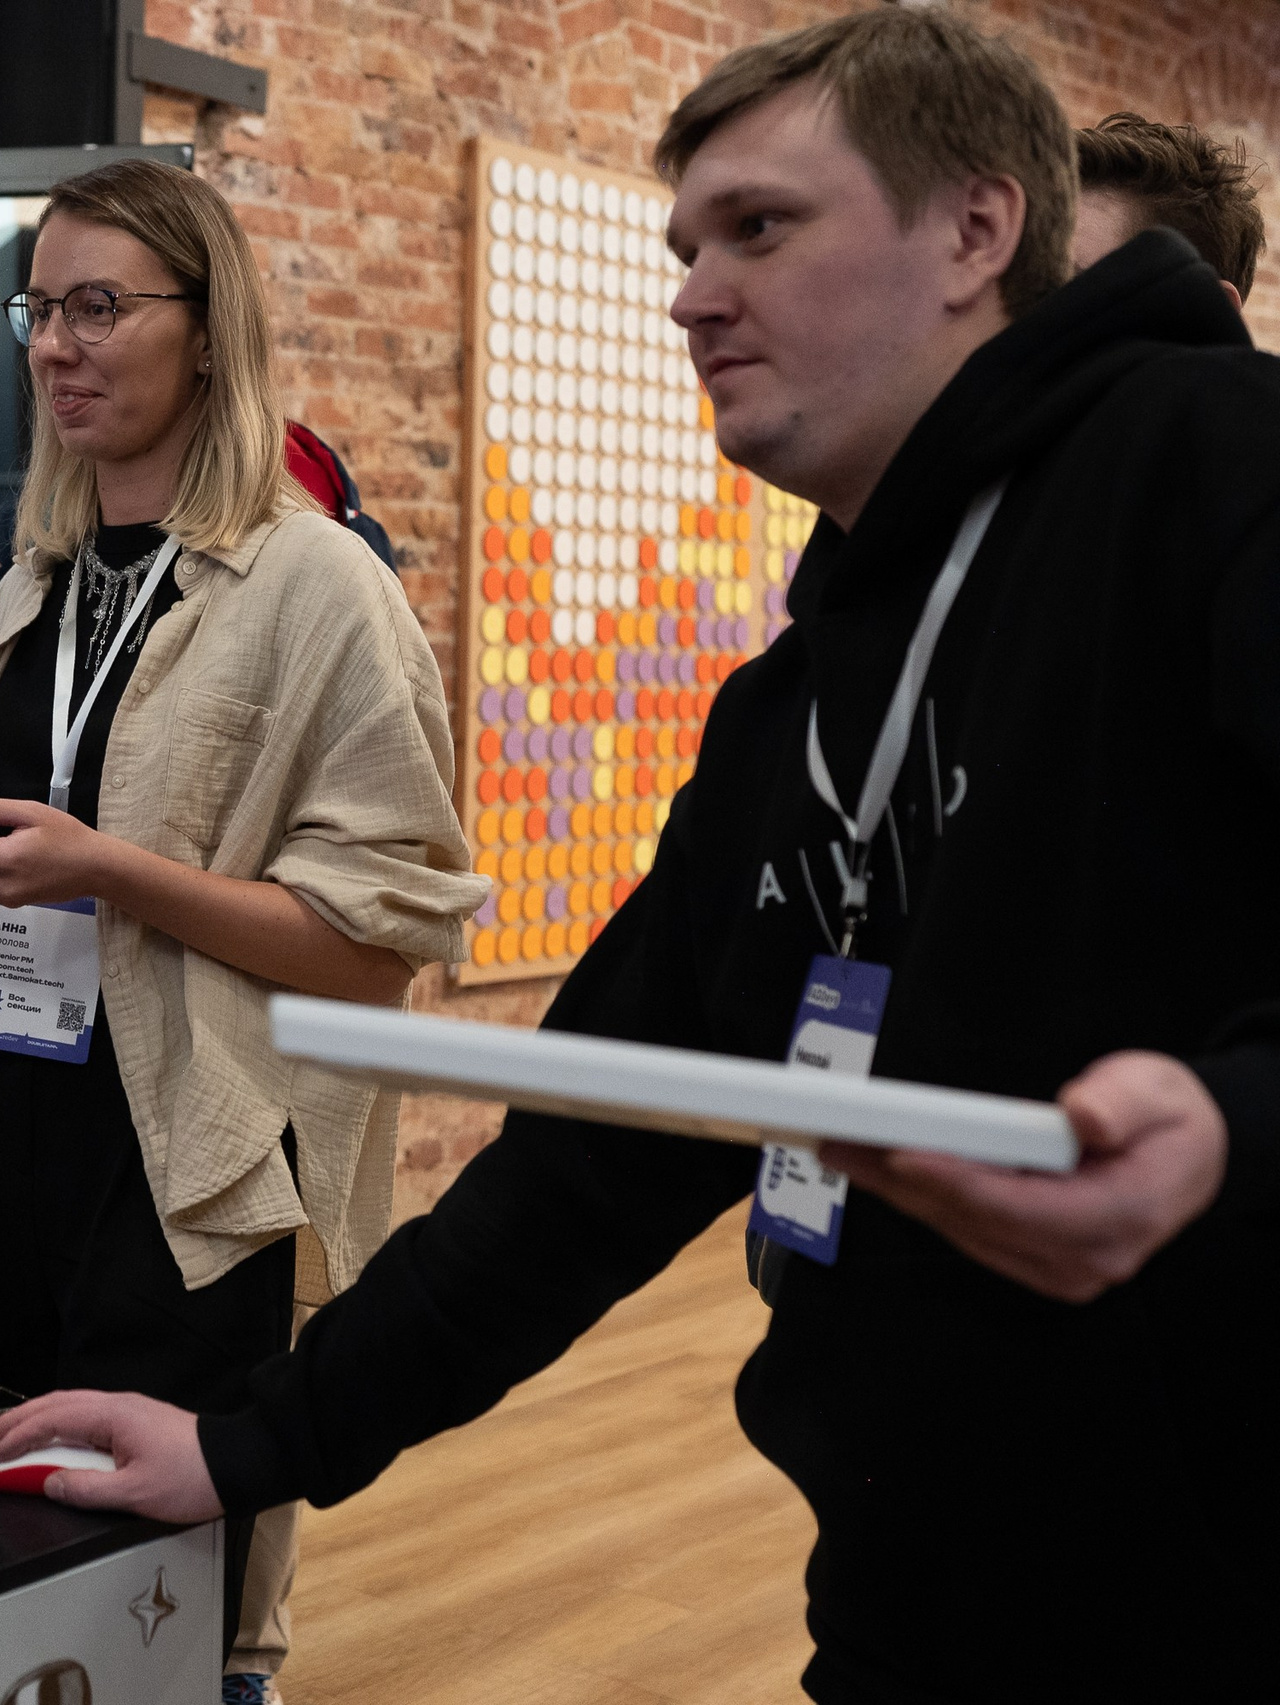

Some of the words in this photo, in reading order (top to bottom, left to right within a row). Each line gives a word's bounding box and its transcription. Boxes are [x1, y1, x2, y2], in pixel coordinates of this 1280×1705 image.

[20, 955, 34, 964] PM
[8, 993, 26, 1003] Все
[6, 1002, 42, 1014] секции
